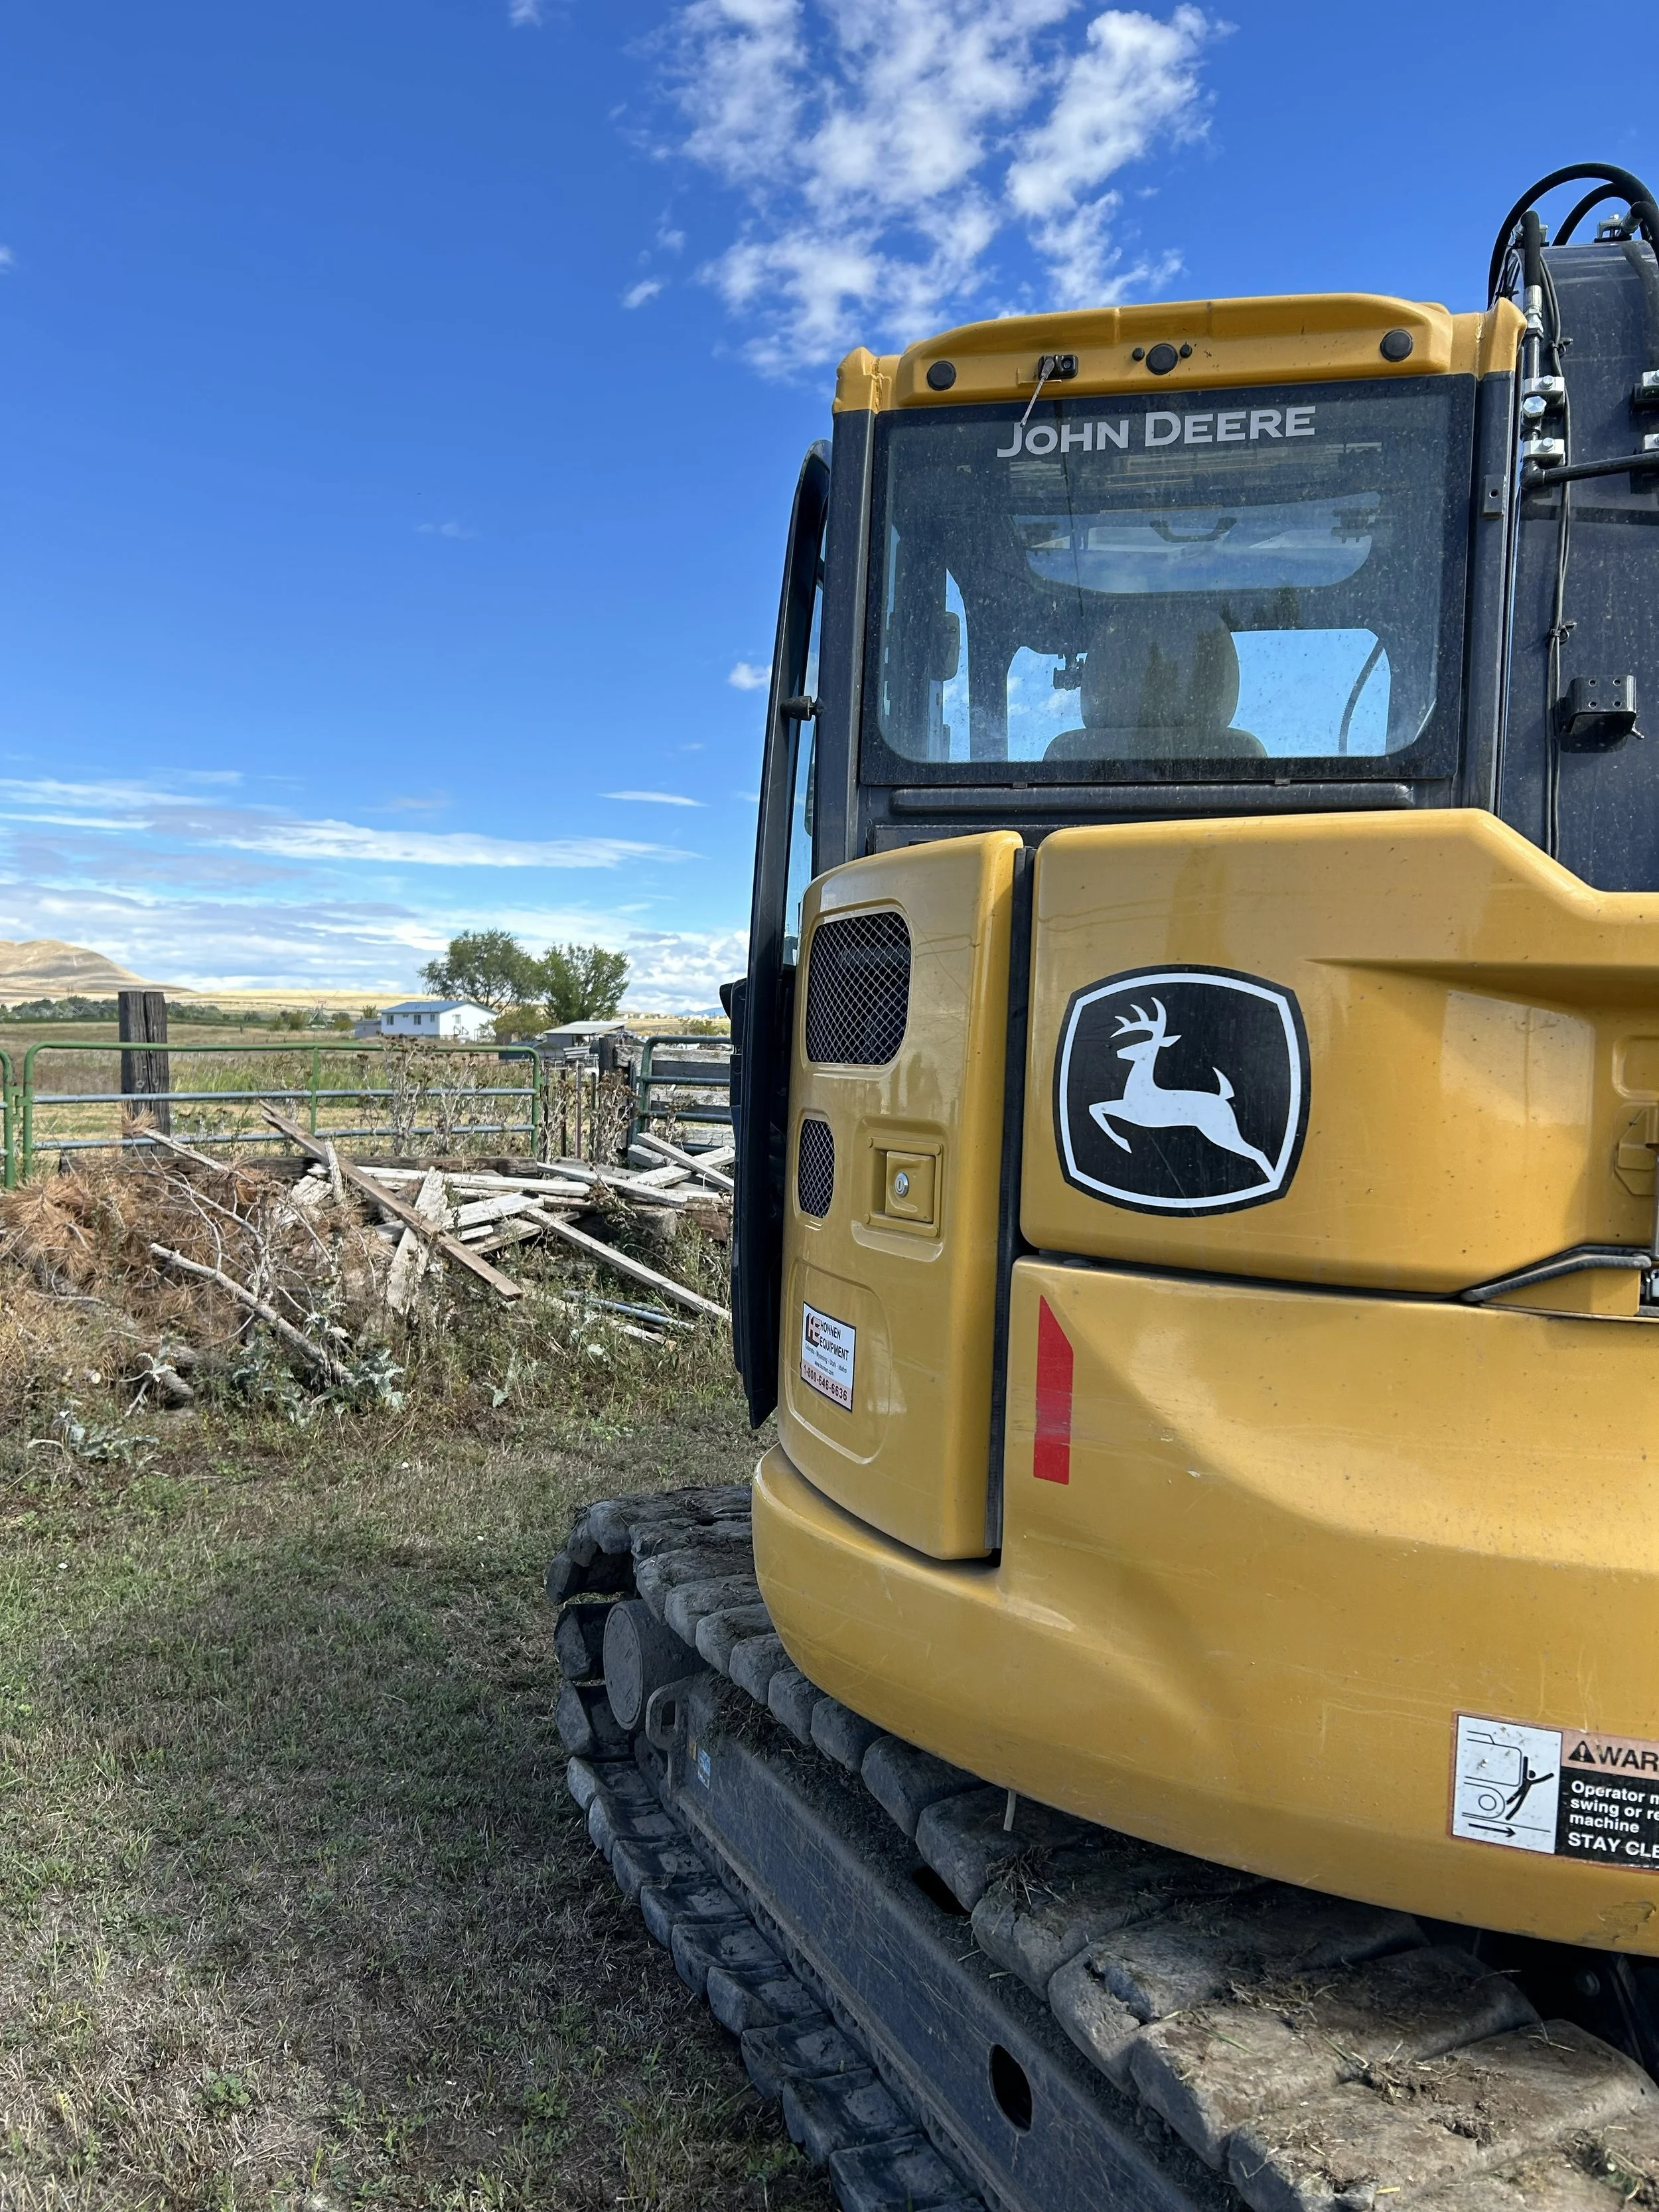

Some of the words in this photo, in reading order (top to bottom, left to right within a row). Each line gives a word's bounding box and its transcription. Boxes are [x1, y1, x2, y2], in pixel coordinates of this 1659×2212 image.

[997, 419, 1129, 458] JOHN
[1145, 406, 1316, 447] DEERE
[820, 1320, 841, 1340] HONNEN
[820, 1336, 849, 1361] EQUIPMENT
[804, 1364, 847, 1401] 1-800-646-6636
[1596, 1745, 1659, 1772] WAR
[1571, 1780, 1646, 1804] Operator
[1570, 1798, 1619, 1817] swing
[1624, 1806, 1642, 1818] or
[1569, 1814, 1640, 1834] machine
[1567, 1832, 1621, 1853] STAY
[1625, 1841, 1659, 1859] CLE
